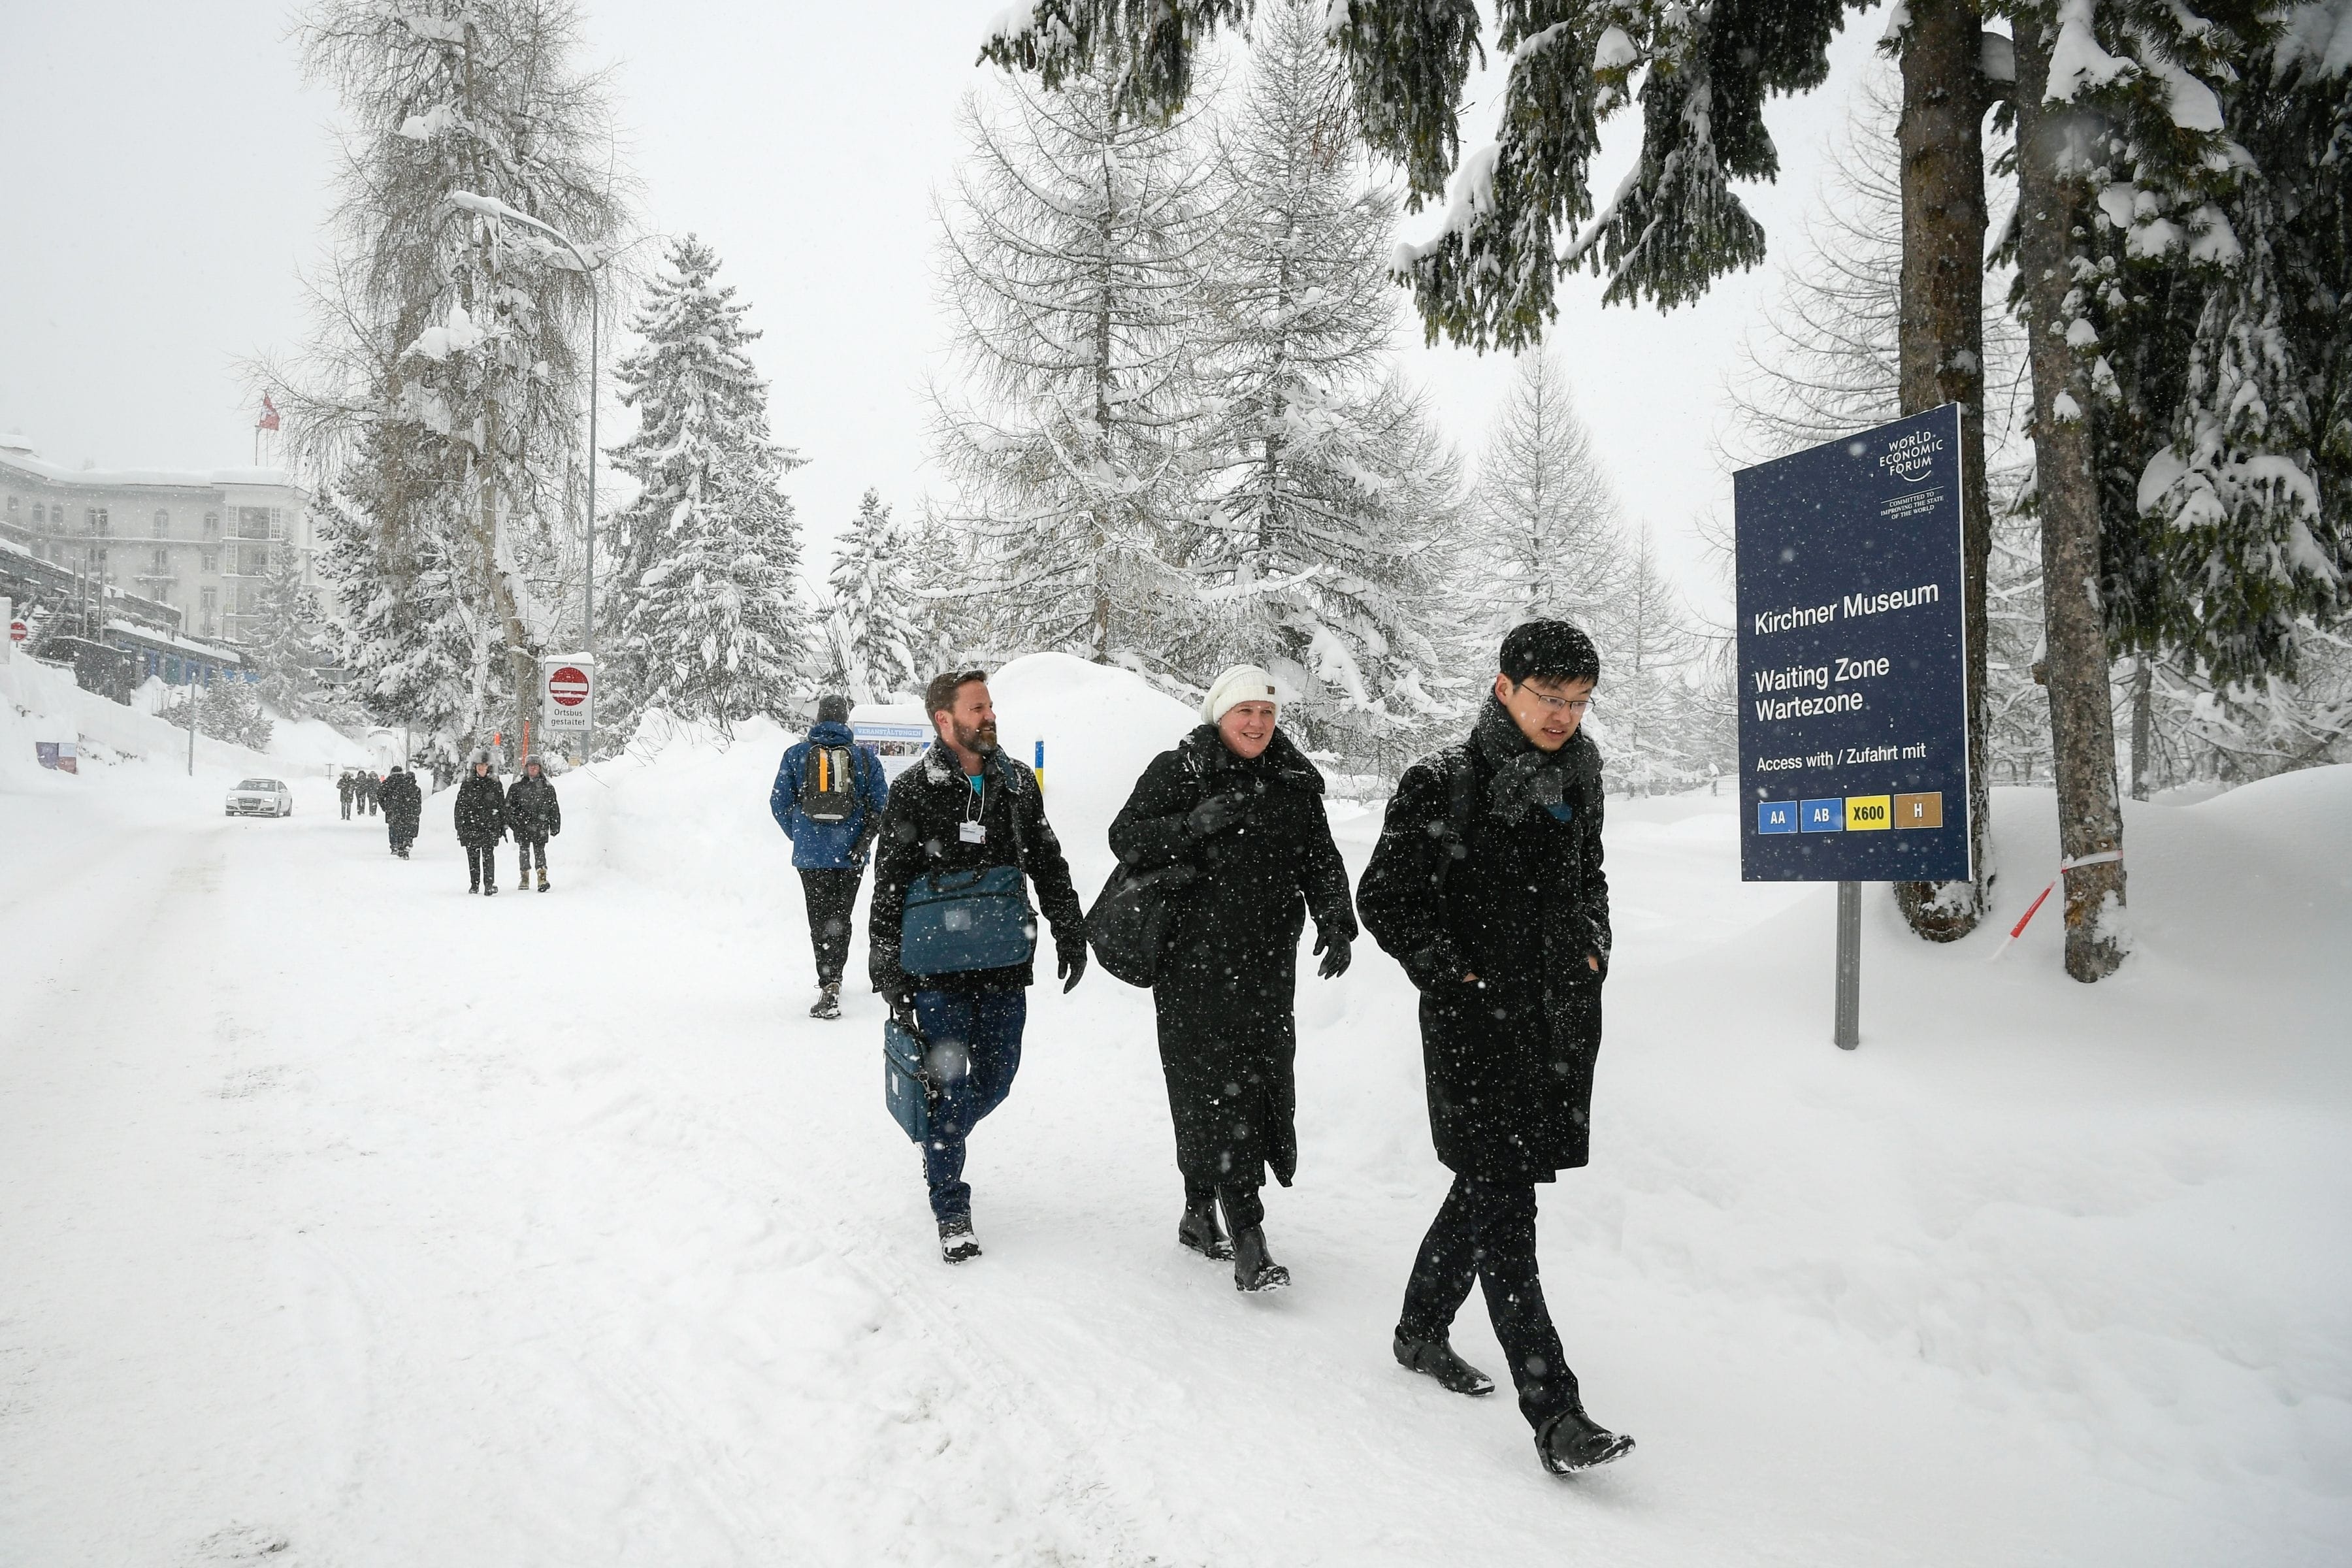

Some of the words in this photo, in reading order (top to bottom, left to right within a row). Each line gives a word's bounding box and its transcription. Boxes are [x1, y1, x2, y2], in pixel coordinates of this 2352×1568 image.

[1889, 431, 1931, 451] WORLD
[1880, 439, 1943, 466] ECONOMIC
[1889, 455, 1931, 476] FORUM
[1880, 503, 1912, 516] IMPROVING
[1927, 495, 1944, 504] STATE
[1889, 494, 1925, 508] COMMITTED
[1913, 504, 1935, 514] WORLD
[1755, 602, 1838, 635] Kirchner
[1843, 583, 1939, 619] Museum
[1755, 664, 1828, 693] Waiting
[1835, 657, 1890, 682] Zone
[554, 708, 583, 717] Ortsbus
[1756, 692, 1863, 722] Wartezone
[857, 728, 922, 736] VERANSTALTUNGEN
[1757, 757, 1803, 772] Access
[1806, 751, 1833, 767] with
[1837, 749, 1843, 765] /
[1846, 745, 1899, 764] Zufahrt
[1903, 742, 1927, 760] mit
[1770, 810, 1786, 825] AA
[1814, 808, 1830, 823] AB
[1853, 806, 1884, 821] X600
[1914, 803, 1923, 818] H
